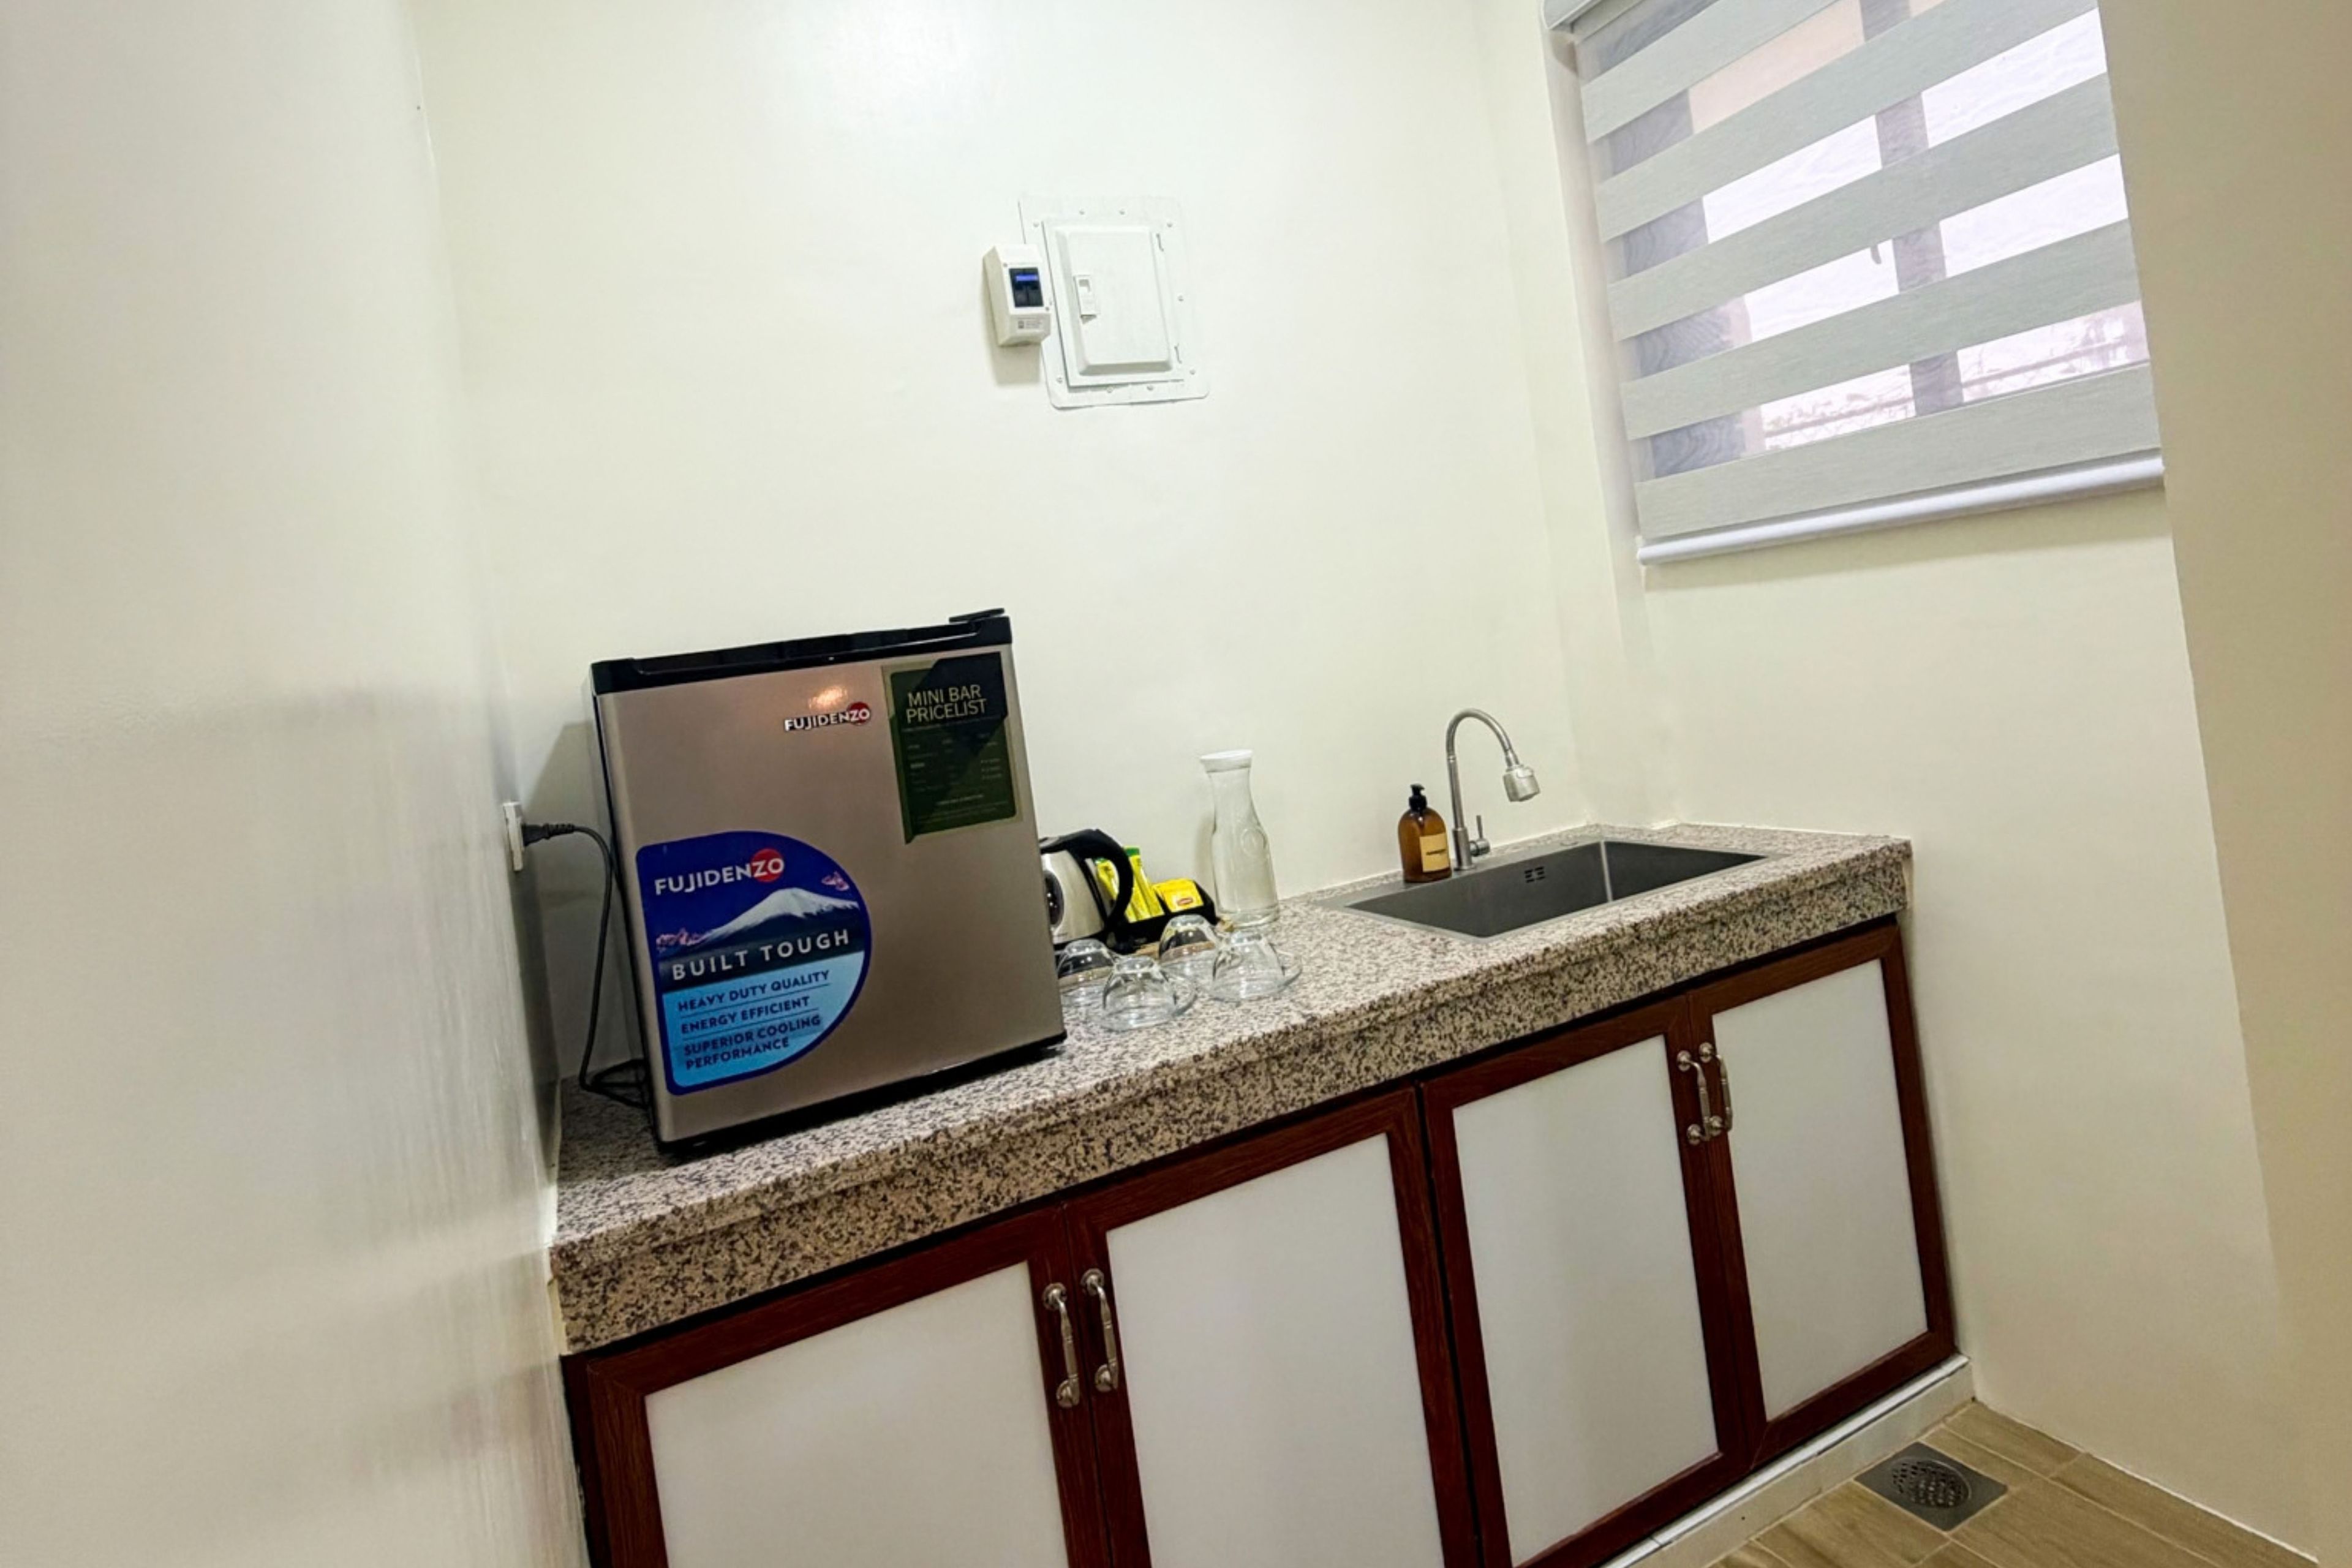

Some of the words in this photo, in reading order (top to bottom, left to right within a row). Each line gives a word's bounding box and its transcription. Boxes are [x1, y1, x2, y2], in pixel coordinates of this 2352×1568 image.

[906, 698, 987, 724] PRICELIST
[907, 688, 945, 707] MINI
[949, 684, 982, 701] BAR
[784, 708, 870, 731] FUJIDENZO
[654, 858, 785, 895] FUJIDENZO
[672, 950, 748, 980] BUILT
[760, 929, 849, 961] TOUGH
[677, 993, 725, 1011] HEAVY
[729, 984, 767, 1001] DUTY
[771, 970, 830, 992] QUALITY
[681, 1012, 737, 1034] ENERGY
[741, 996, 810, 1021] EFFICIENT
[684, 1031, 754, 1056] SUPERIOR
[757, 1014, 821, 1038] COOLING
[685, 1037, 790, 1070] PERFORMANCE
